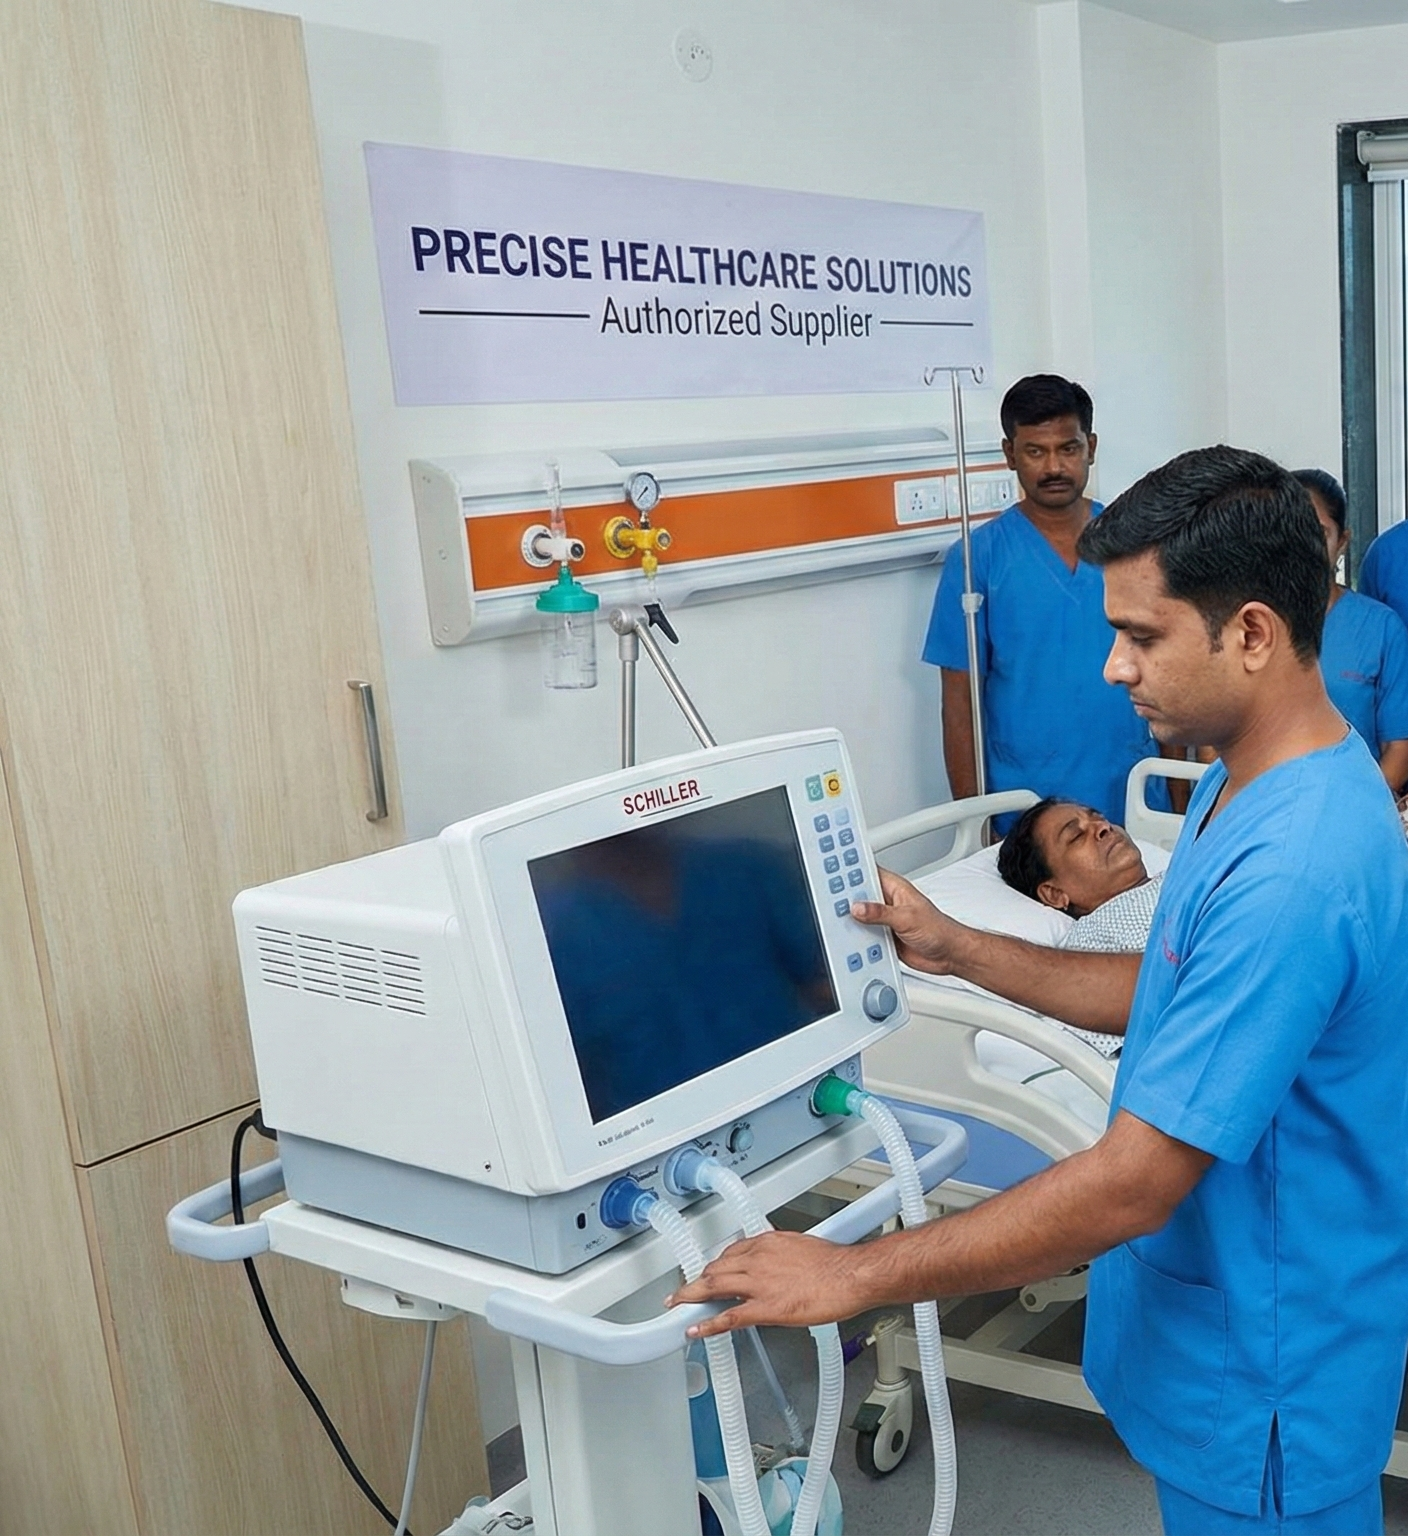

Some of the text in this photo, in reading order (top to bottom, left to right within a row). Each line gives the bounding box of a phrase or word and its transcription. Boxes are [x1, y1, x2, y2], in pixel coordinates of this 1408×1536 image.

[411, 226, 972, 298] PRECISE HEALTHCARE SOLUTIONS
[600, 296, 873, 345] Authorized Supplier
[623, 779, 700, 815] SCHILLER
